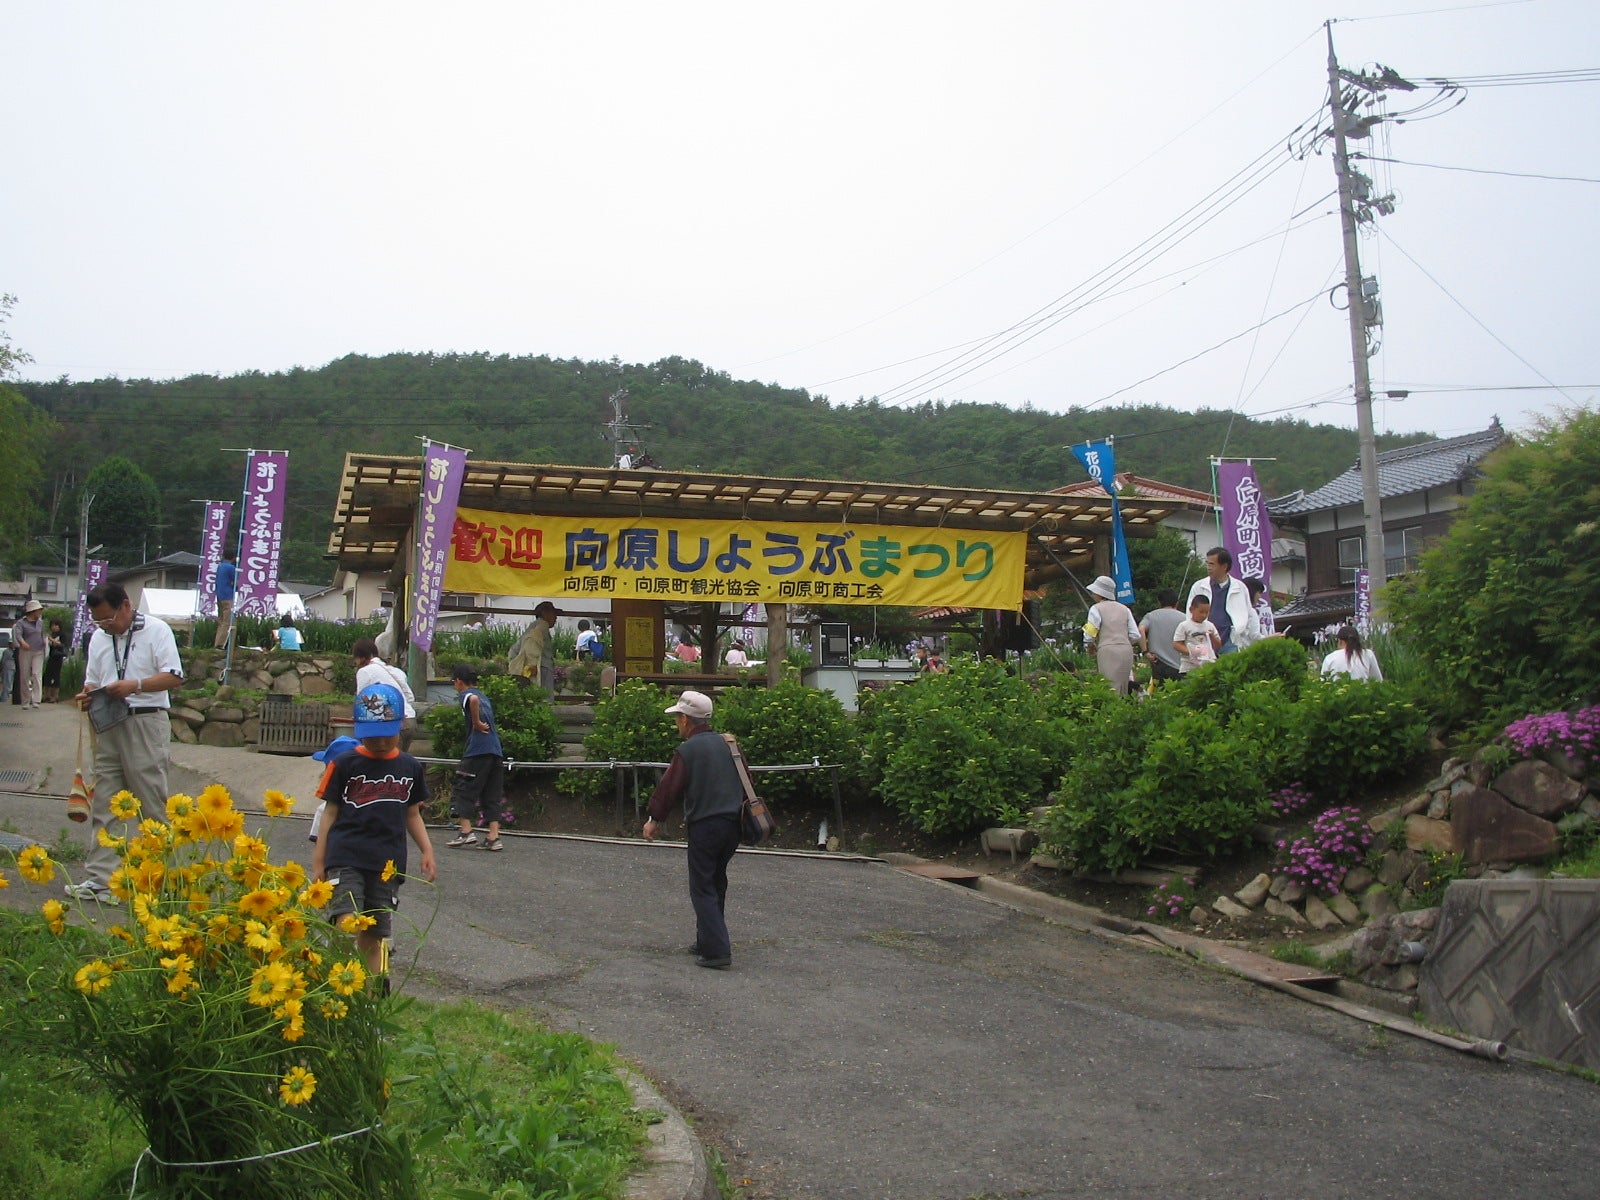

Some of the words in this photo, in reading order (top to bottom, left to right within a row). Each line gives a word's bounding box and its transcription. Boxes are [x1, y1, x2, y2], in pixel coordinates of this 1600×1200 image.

[450, 517, 543, 570] 歓迎
[564, 527, 994, 582] 向原しょうぶまつり
[1236, 476, 1267, 592] 向原町商
